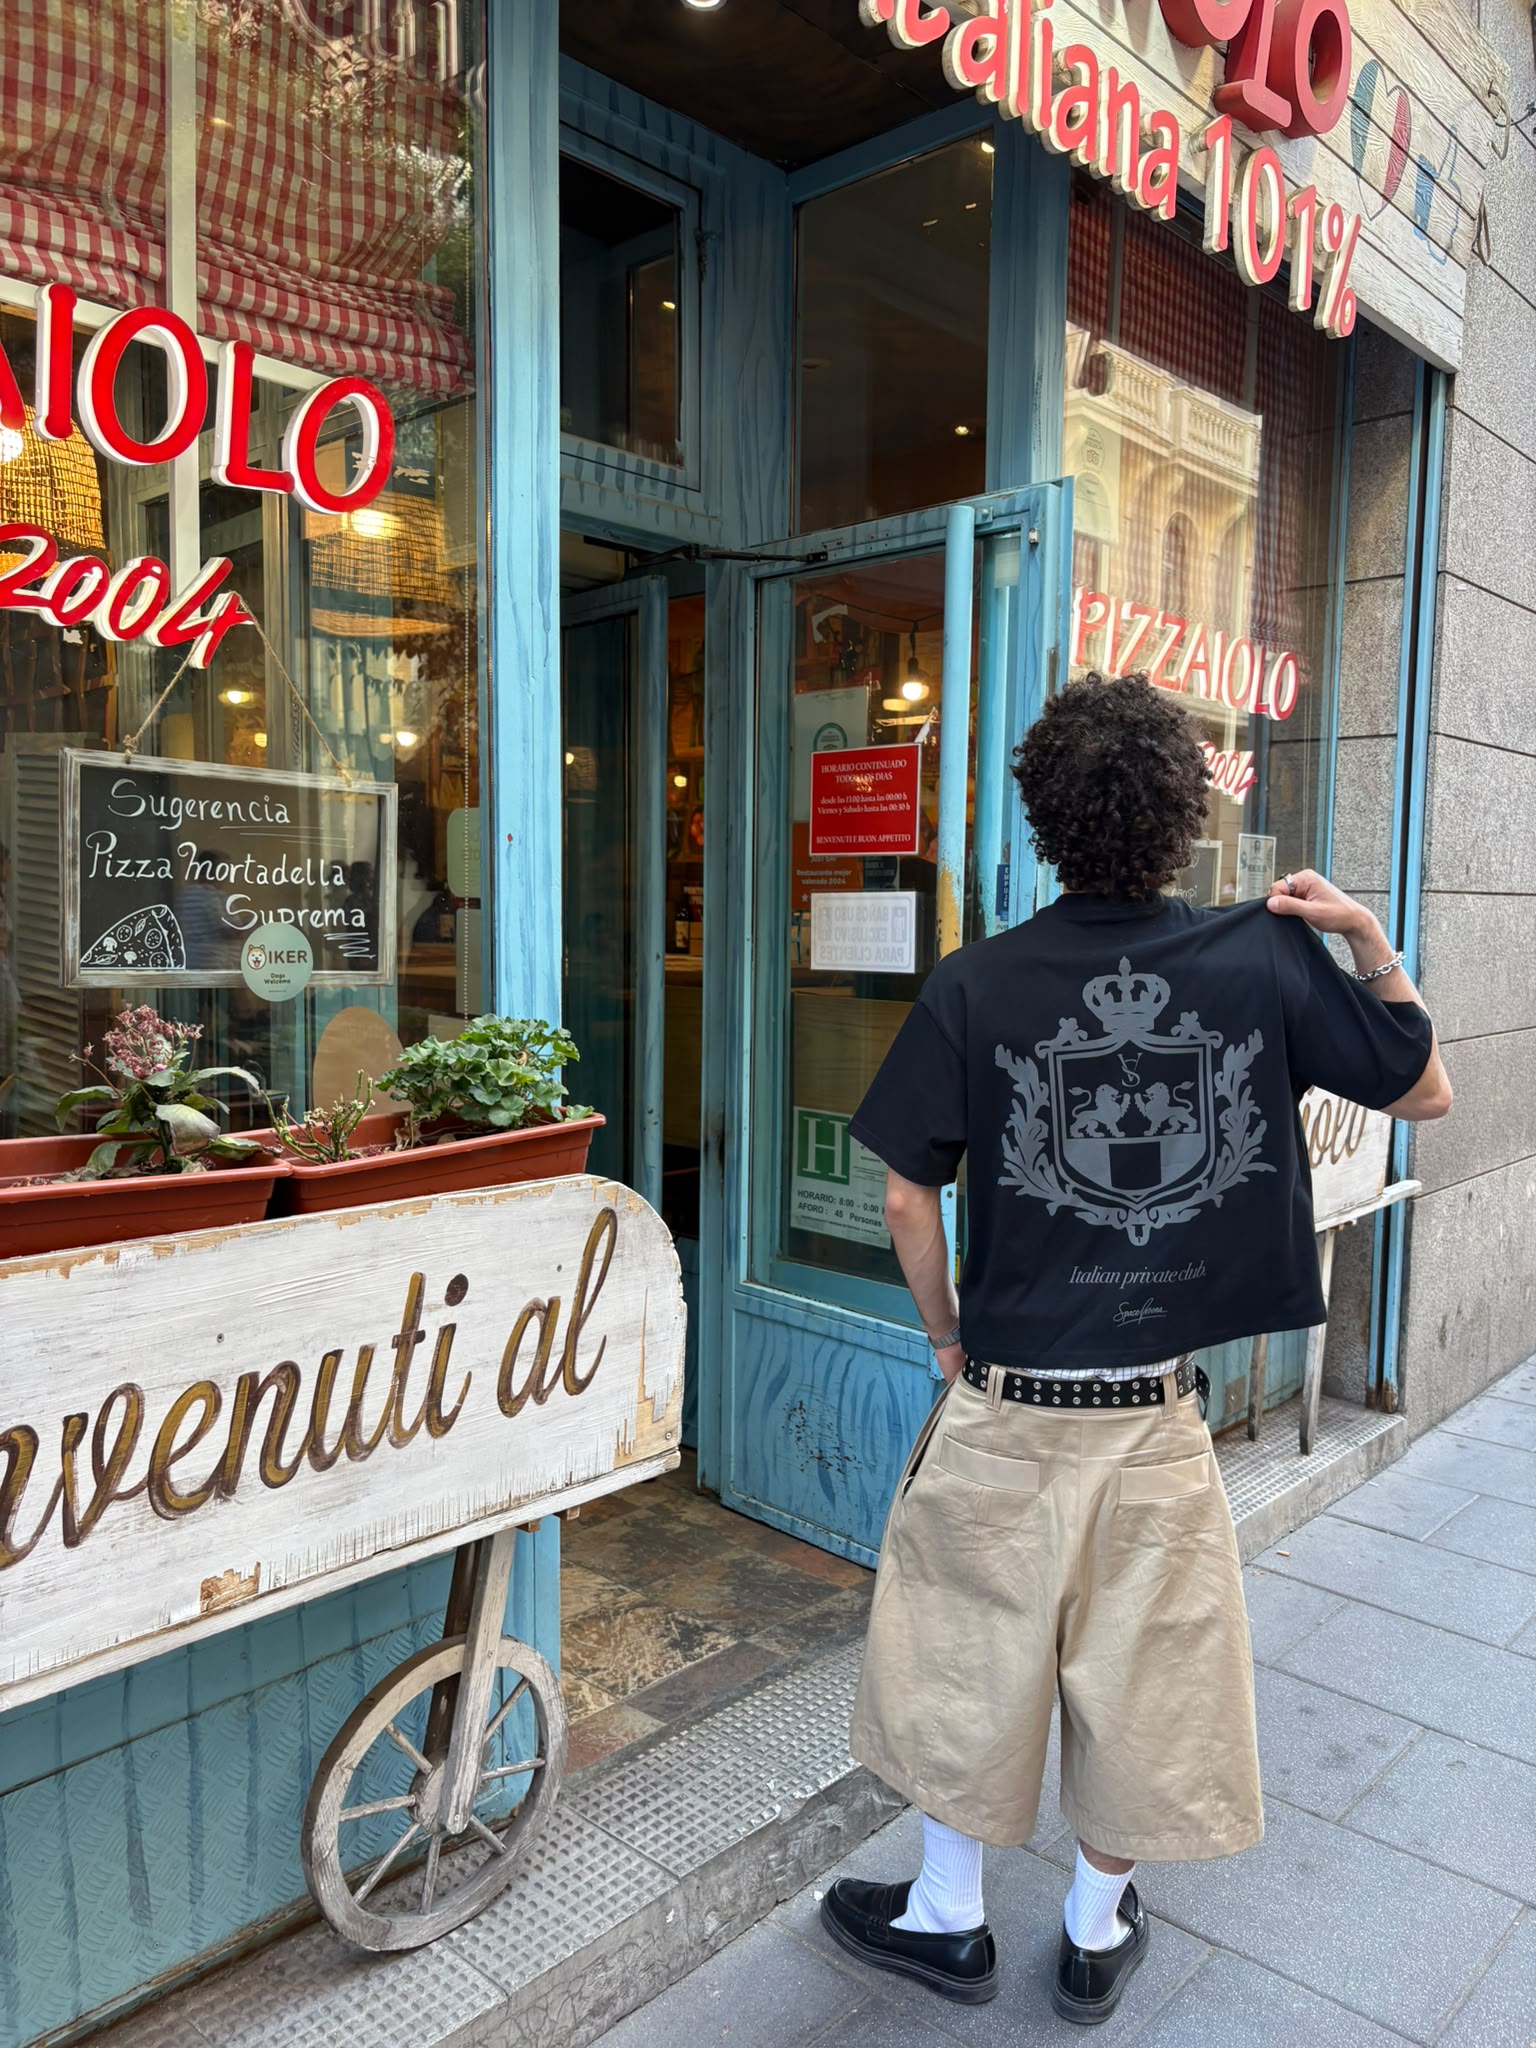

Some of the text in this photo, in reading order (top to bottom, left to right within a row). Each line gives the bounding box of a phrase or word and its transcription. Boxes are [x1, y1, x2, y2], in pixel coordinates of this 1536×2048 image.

[860, 0, 1362, 339] aliana 101%
[0, 522, 258, 669] 2004
[1070, 586, 1300, 721] PIZZAIOLO
[821, 759, 907, 773] HORARIO CONTINUADO
[108, 778, 291, 831] Sugerencia
[86, 830, 174, 879] Pizza
[816, 835, 852, 844] BENVENUTI
[878, 834, 911, 843] APPETITO
[802, 1116, 849, 1180] H
[797, 1189, 836, 1205] HORARIO:
[834, 1210, 844, 1218] 45
[849, 1212, 882, 1227] Personas
[1069, 1265, 1121, 1284] Italian
[1120, 1265, 1177, 1290] private
[496, 1206, 617, 1419] al
